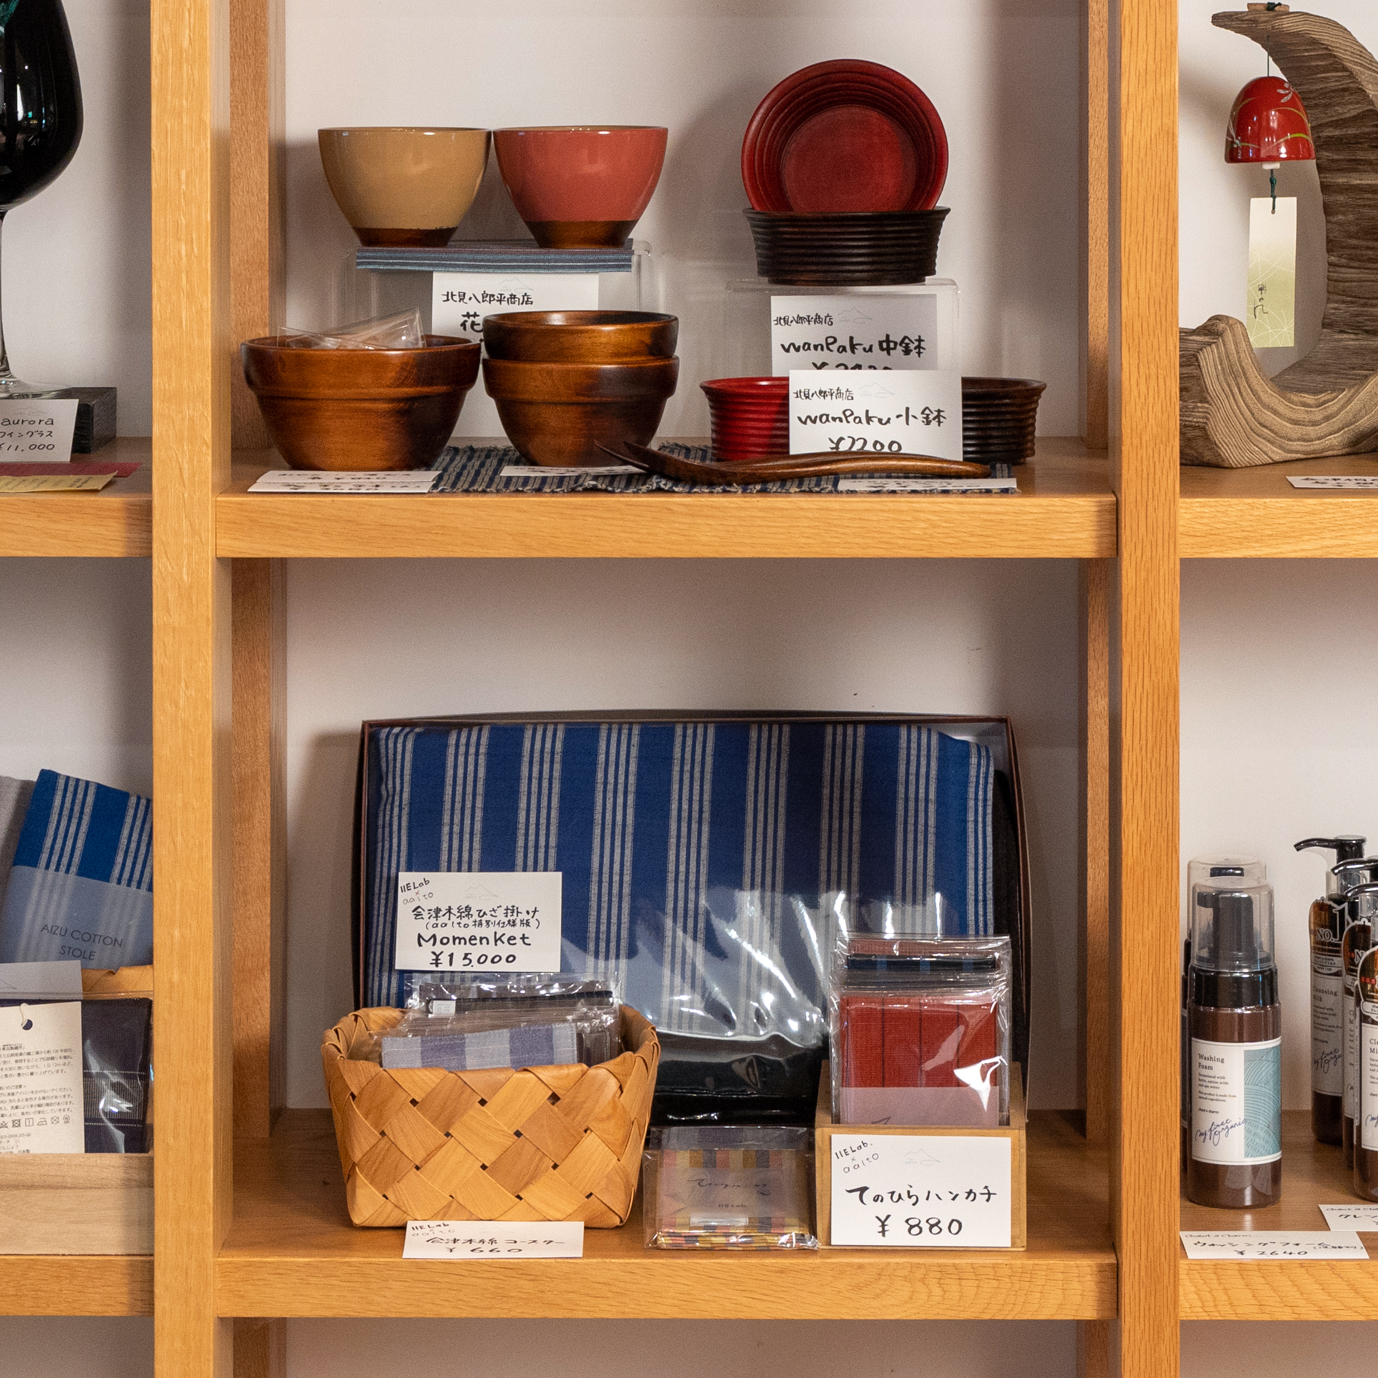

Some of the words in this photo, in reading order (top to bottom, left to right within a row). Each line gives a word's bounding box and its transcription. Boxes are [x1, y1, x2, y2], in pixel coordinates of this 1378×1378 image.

[441, 290, 534, 306] 北見八郎平商店
[460, 310, 484, 334] 花
[0, 417, 55, 427] aurora
[828, 436, 903, 453] ¥2200
[411, 904, 540, 921] 会津木綿ひざ掛け
[41, 923, 68, 937] AIZU
[70, 929, 123, 948] COTTON
[59, 945, 96, 961] STOLE
[1198, 1053, 1225, 1064] Washing
[1198, 1062, 1214, 1071] Foam
[849, 1141, 873, 1155] Lab.
[843, 1153, 880, 1174] aalto
[845, 1185, 998, 1207] てのひらハンカチ
